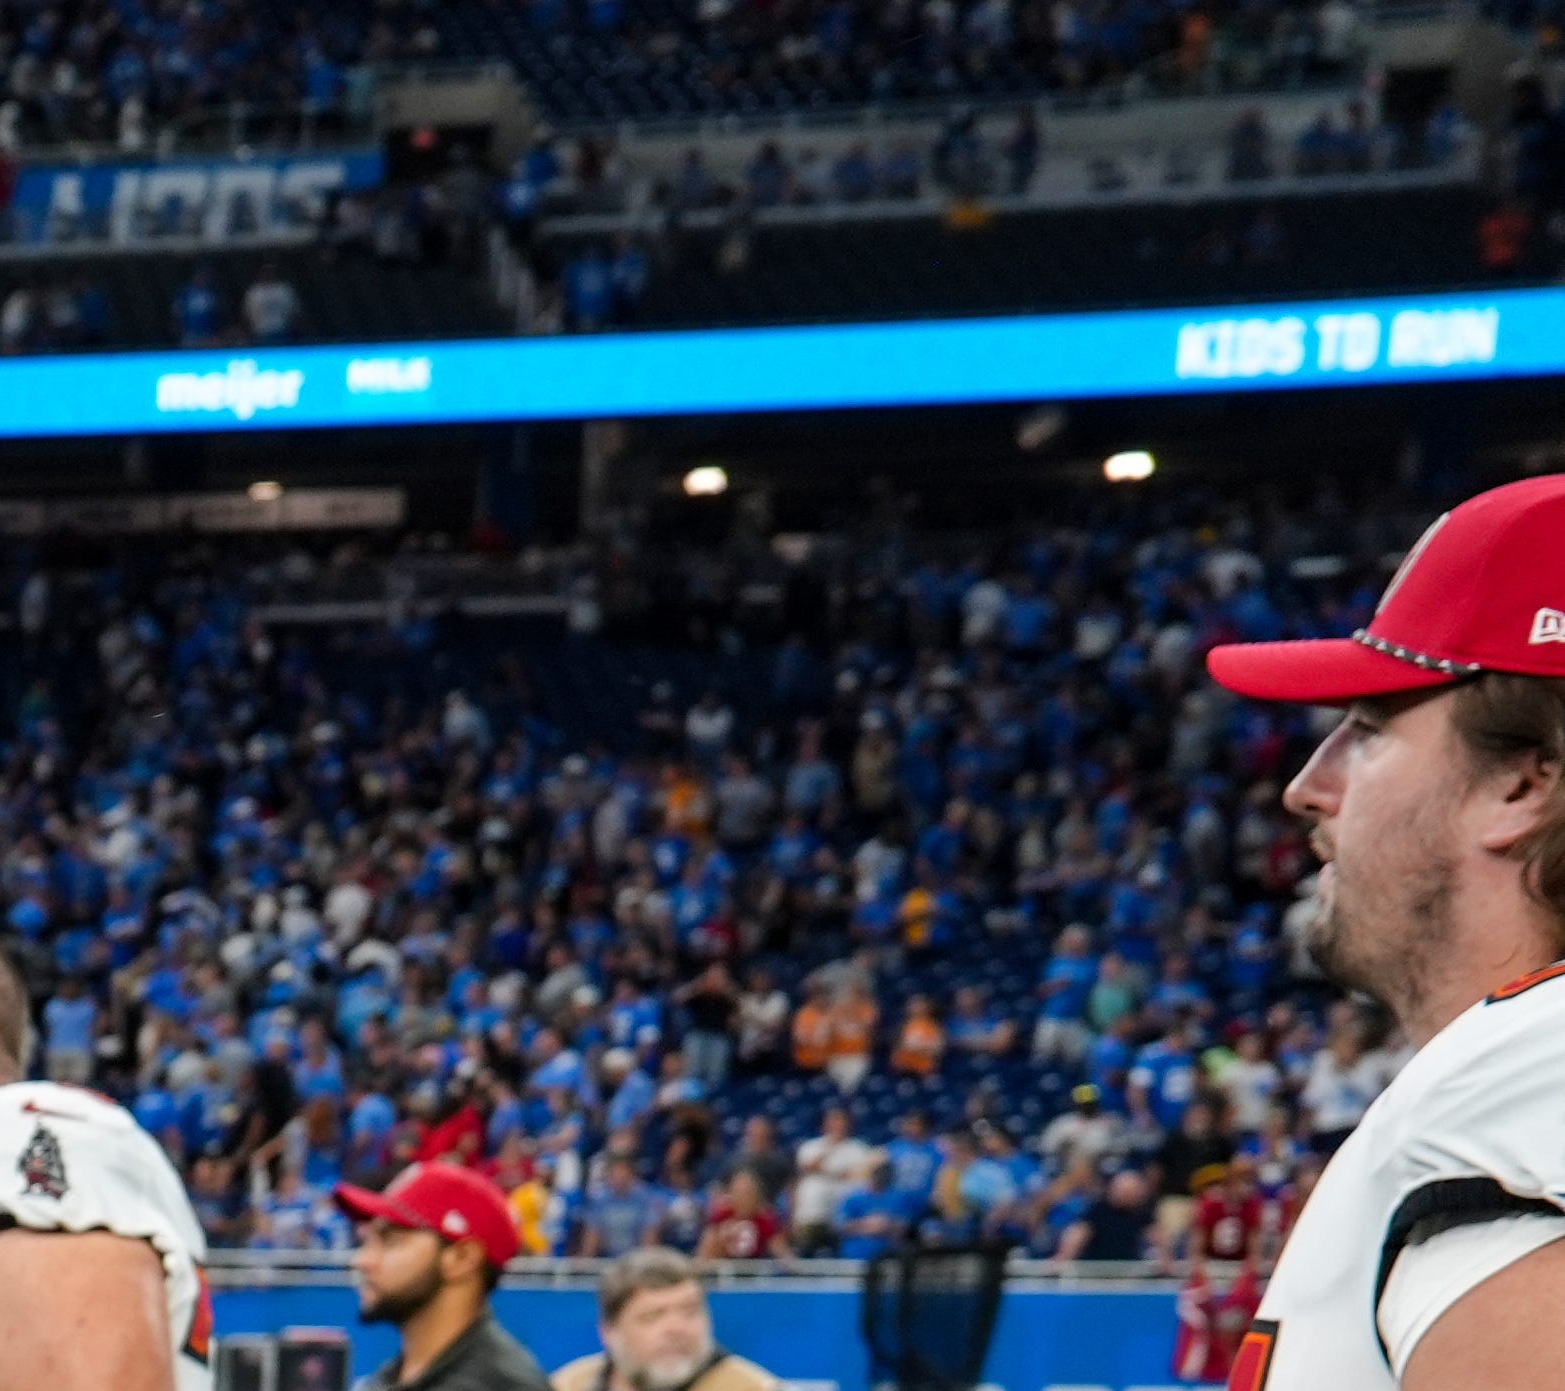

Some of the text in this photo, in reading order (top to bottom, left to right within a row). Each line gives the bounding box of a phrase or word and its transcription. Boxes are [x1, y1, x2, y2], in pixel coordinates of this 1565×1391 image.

[1175, 306, 1500, 379] KIDS TO RUN
[156, 358, 304, 421] meijer
